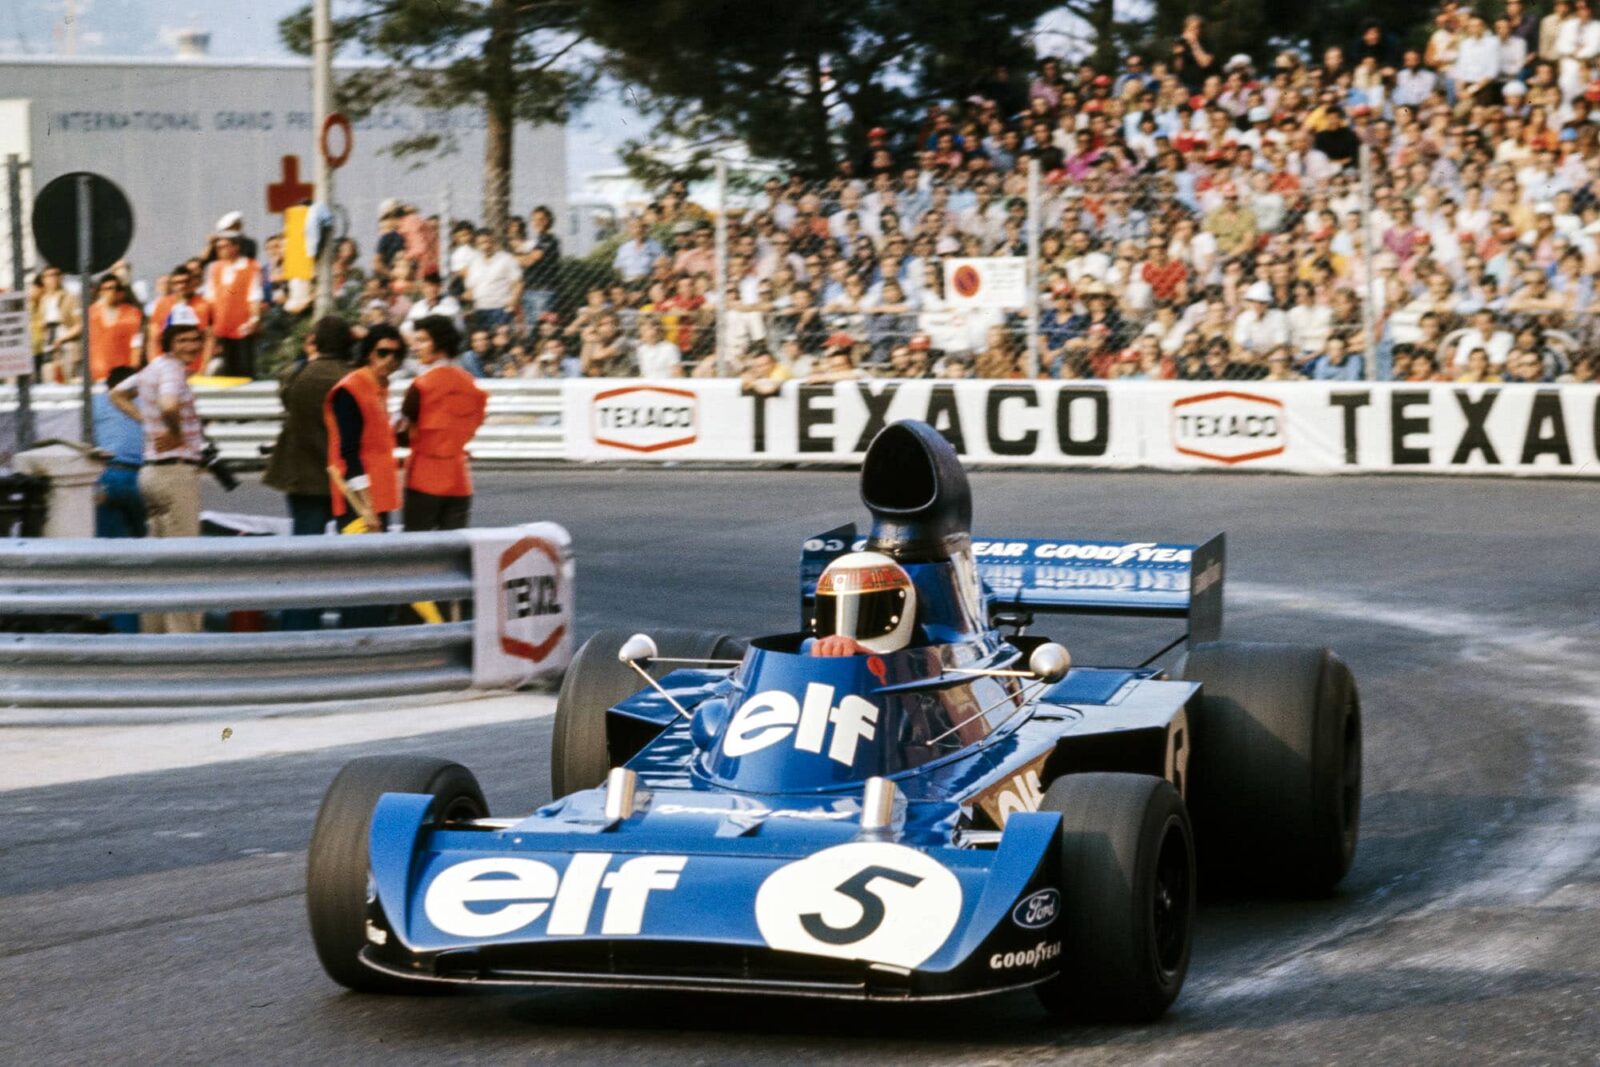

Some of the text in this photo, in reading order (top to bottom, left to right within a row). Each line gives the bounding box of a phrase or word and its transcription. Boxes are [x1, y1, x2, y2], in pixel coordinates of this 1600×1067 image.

[214, 112, 272, 130] GRAND
[600, 407, 693, 428] TEXACO
[742, 383, 1110, 455] TEXACO
[1179, 415, 1279, 437] TEXACO
[1329, 389, 1600, 465] TEXA
[1033, 542, 1192, 565] GOODYEA
[723, 681, 880, 767] elf
[424, 852, 689, 937] elf
[799, 865, 925, 945] 5
[1025, 894, 1056, 923] Ford
